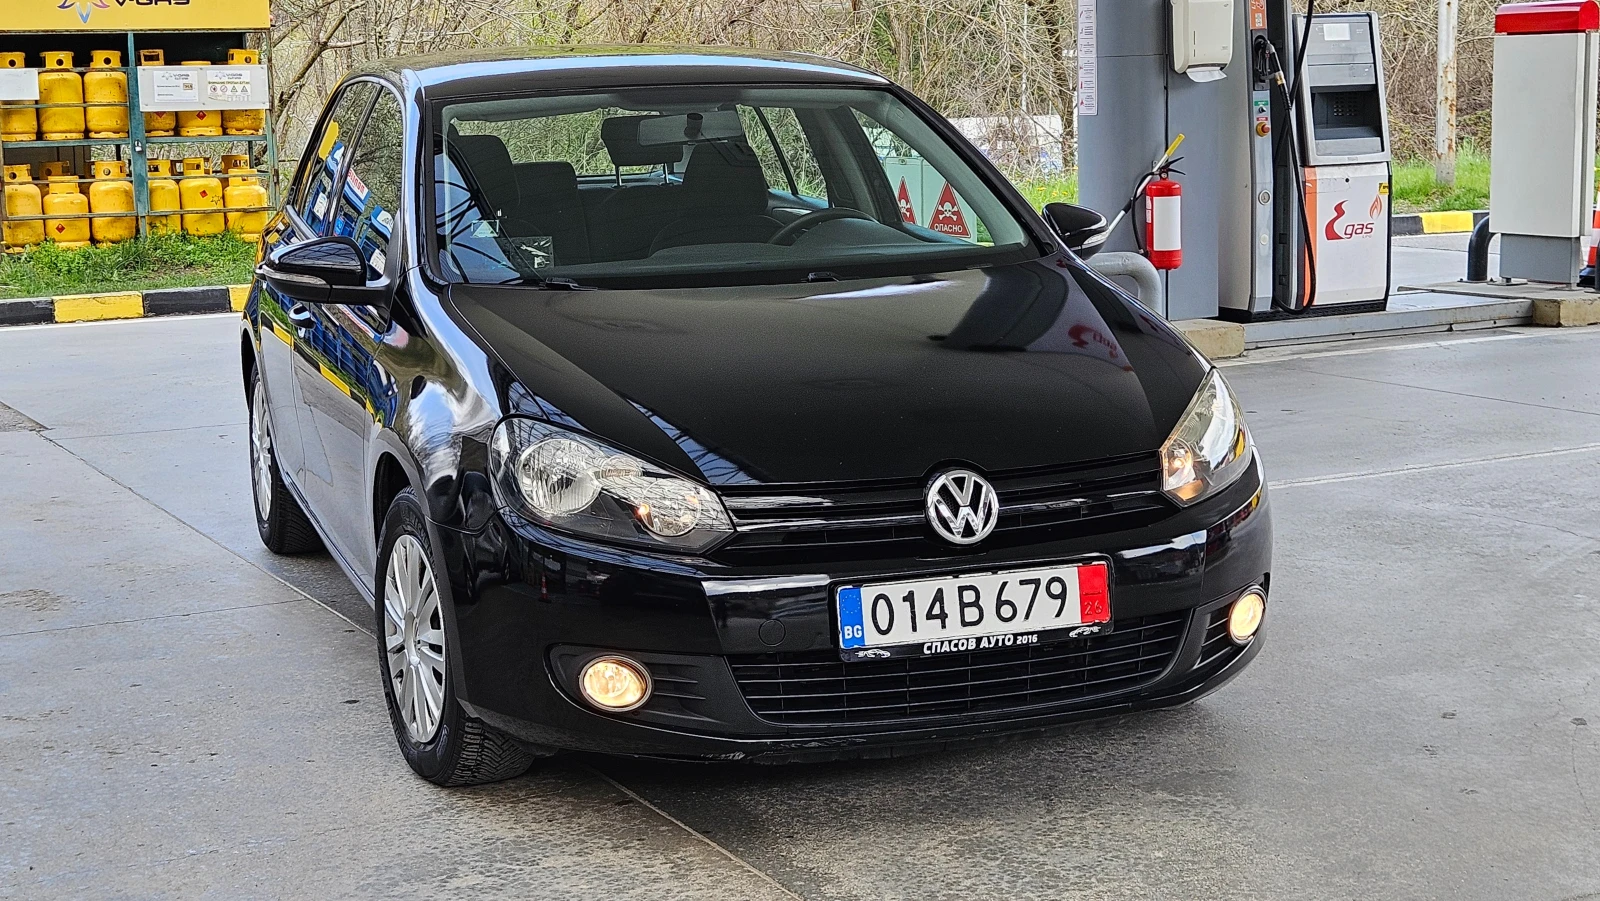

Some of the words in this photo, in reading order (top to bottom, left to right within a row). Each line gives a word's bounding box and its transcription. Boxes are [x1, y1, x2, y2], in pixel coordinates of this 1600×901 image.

[934, 223, 963, 233] ОПАСНО
[1084, 600, 1103, 616] 26
[843, 624, 863, 639] BG
[923, 636, 976, 656] СПАСОВ
[979, 633, 1014, 649] АУТО
[1016, 634, 1038, 645] 2016
